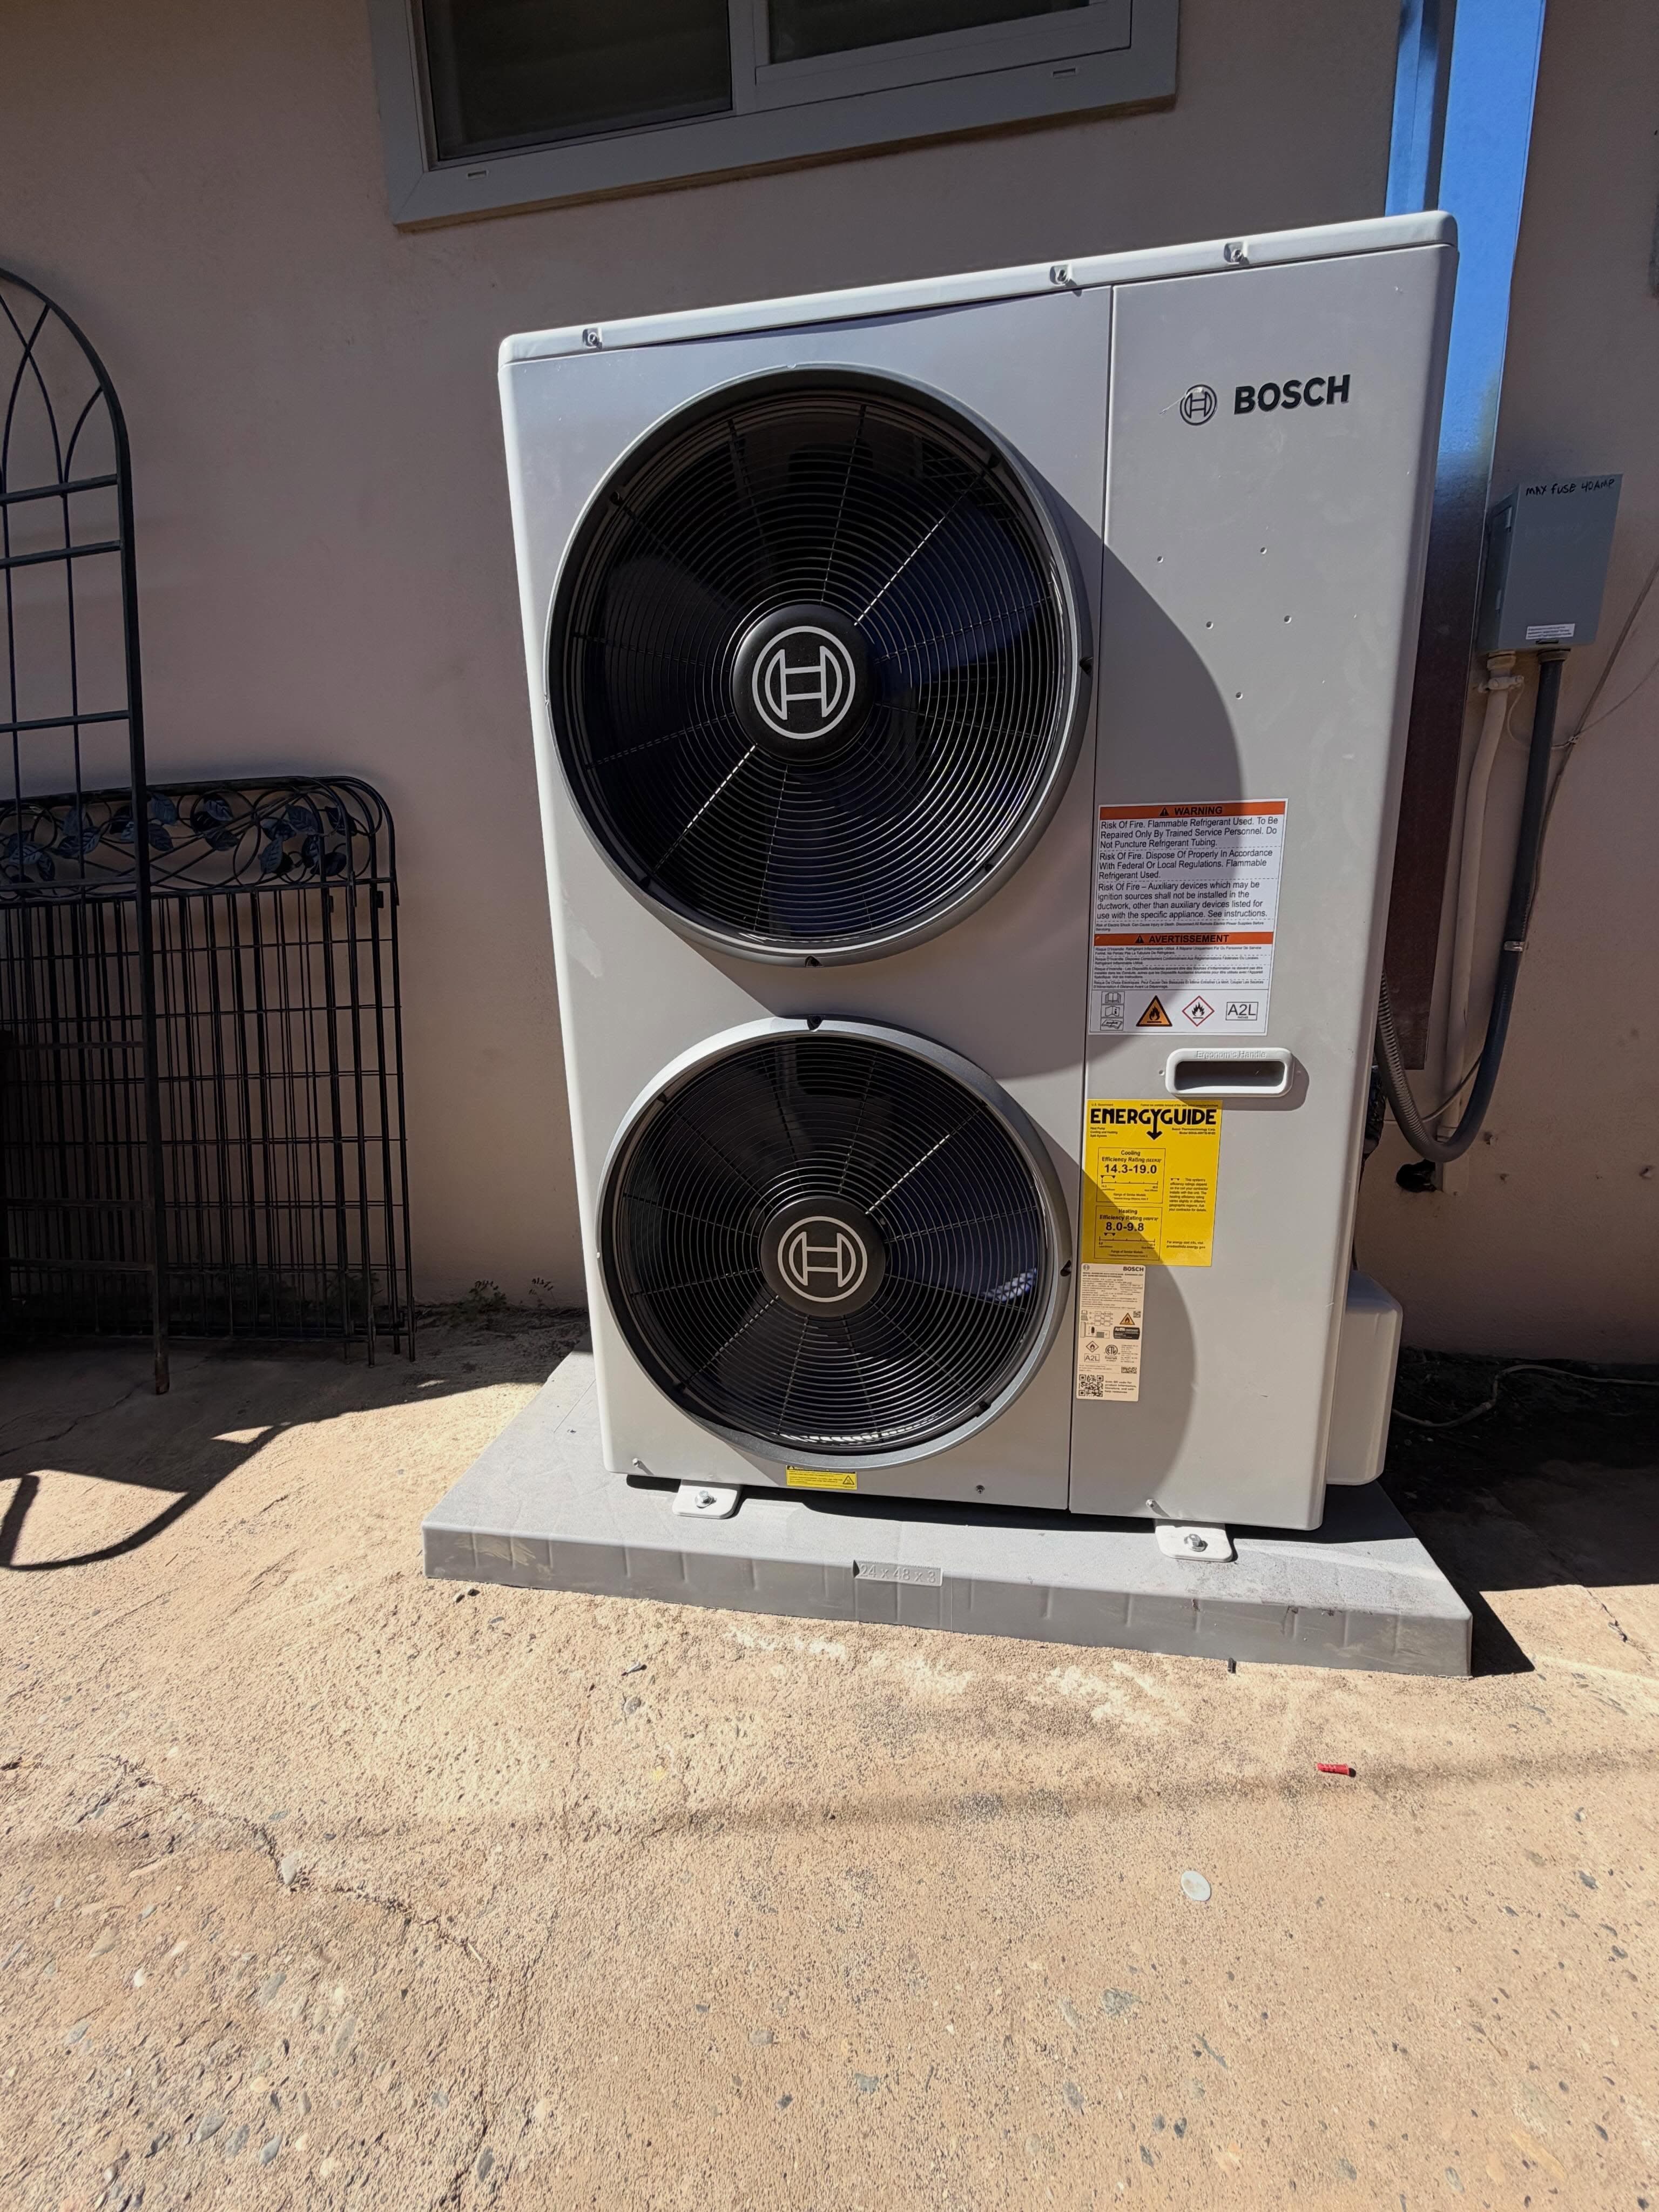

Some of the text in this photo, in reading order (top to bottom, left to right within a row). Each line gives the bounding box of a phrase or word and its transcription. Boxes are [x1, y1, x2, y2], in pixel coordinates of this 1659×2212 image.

[1234, 374, 1350, 415] BOSCH
[1175, 806, 1223, 815] WARNING
[1101, 821, 1116, 829] Risk
[1148, 819, 1188, 827] Flammable
[1190, 818, 1230, 827] Refrigerant
[1257, 817, 1265, 825] To
[1101, 831, 1133, 839] Repaired
[1135, 830, 1151, 839] Only
[1154, 830, 1163, 839] By
[1166, 829, 1192, 837] Trained
[1149, 839, 1188, 848] Refrigerant
[1191, 839, 1217, 847] Tubing.
[1146, 852, 1175, 860] Dispose
[1188, 850, 1218, 859] Properly
[1229, 849, 1272, 857] Accordance
[1179, 860, 1223, 869] Regulations.
[1099, 872, 1138, 880] Refrigerant
[1148, 882, 1178, 891] Auxiliary
[1098, 893, 1122, 902] ignition
[1171, 901, 1200, 909] auxiliary
[1141, 911, 1167, 920] specific
[1169, 911, 1205, 919] appliance.
[1149, 935, 1230, 943] AVERTISSEMENT
[1228, 1004, 1256, 1015] A2L
[1196, 1050, 1266, 1059] Ergonomic Handle
[1090, 1108, 1217, 1125] ENERGYGUIDE
[1105, 1164, 1157, 1174] 14.3-19.0
[1106, 1222, 1144, 1231] 8.0-9.8
[860, 1564, 876, 1577] 24
[893, 1567, 910, 1580] 48
[928, 1569, 935, 1583] 3
